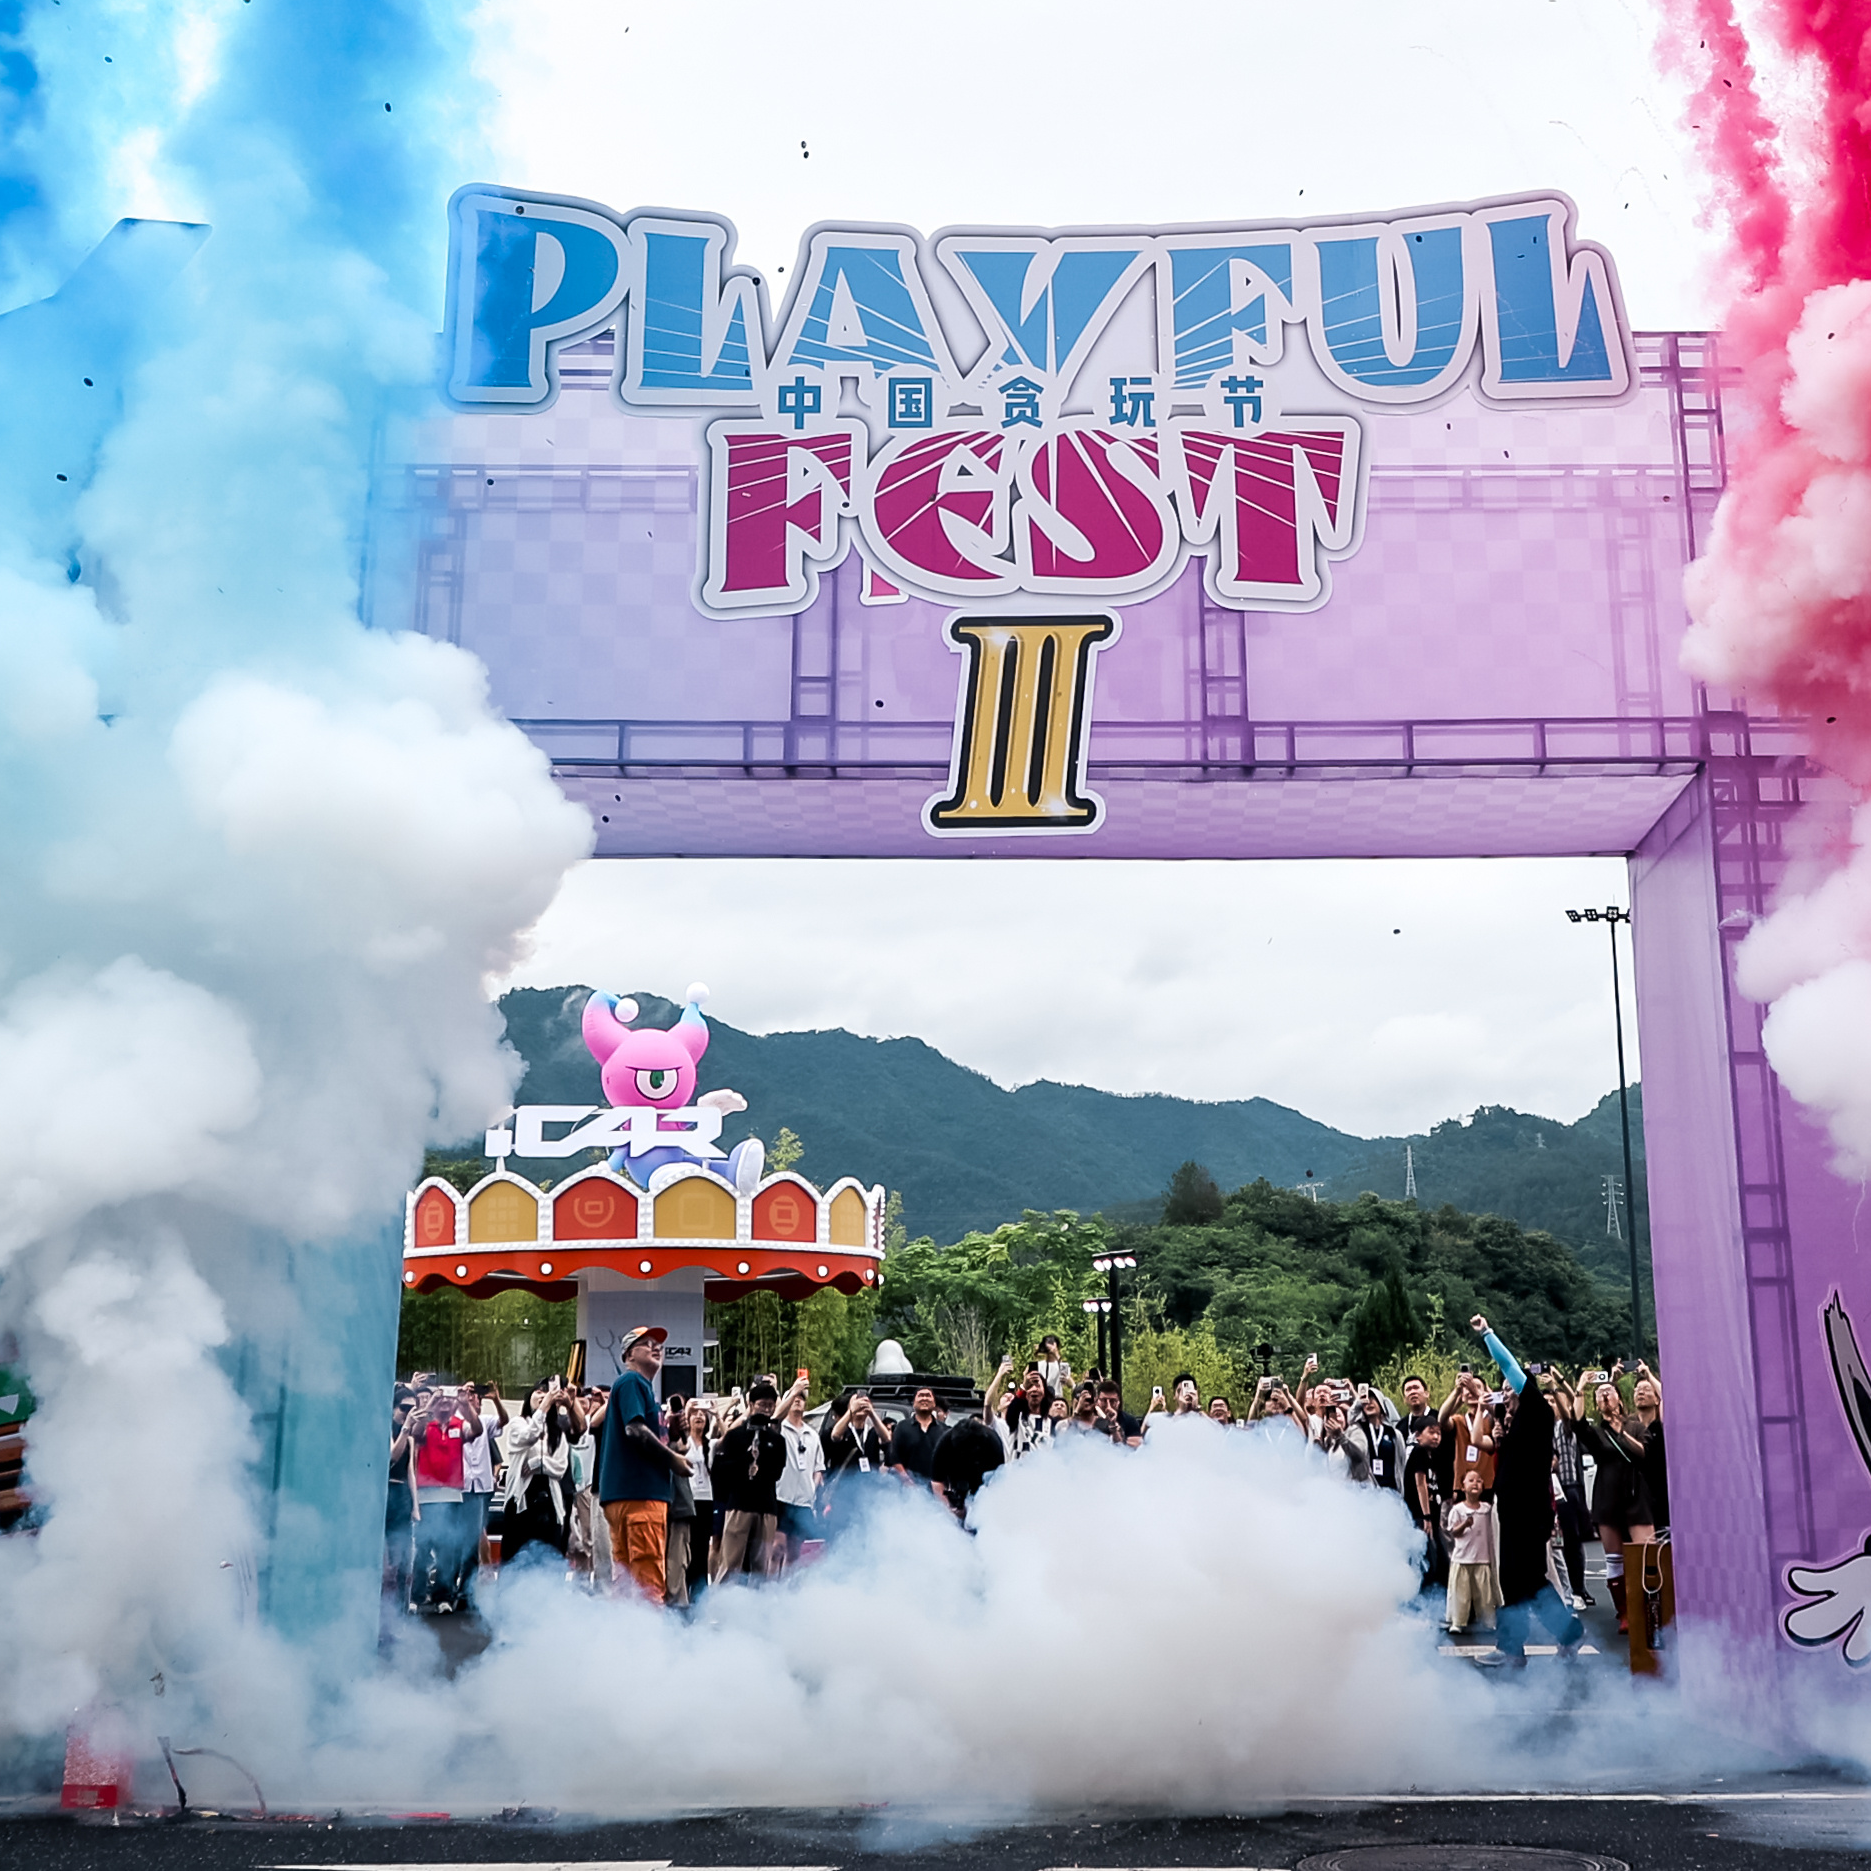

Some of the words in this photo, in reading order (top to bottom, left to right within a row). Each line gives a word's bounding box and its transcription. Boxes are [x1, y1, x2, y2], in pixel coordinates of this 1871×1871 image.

[471, 205, 1616, 394] PLAYFUL
[777, 374, 1265, 429] 中国贪玩节
